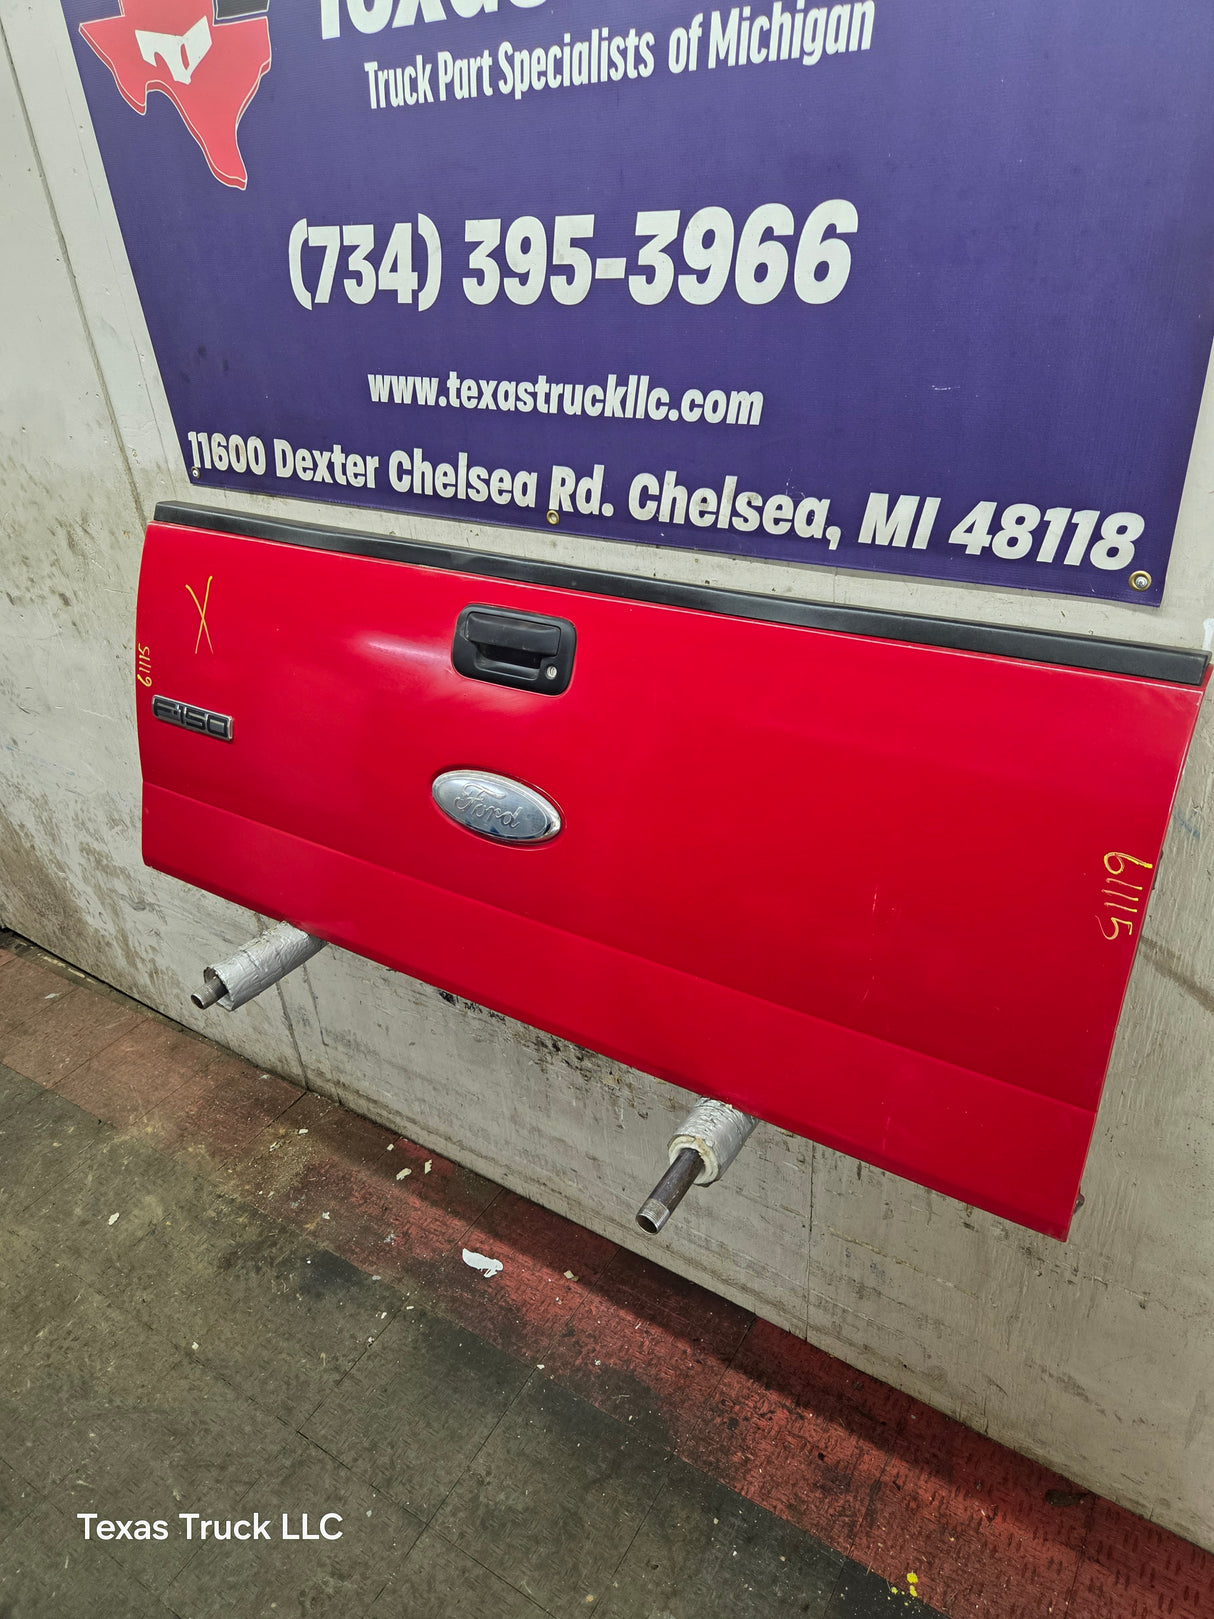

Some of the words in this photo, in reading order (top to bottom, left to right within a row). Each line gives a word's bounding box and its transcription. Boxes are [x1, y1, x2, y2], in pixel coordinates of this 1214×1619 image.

[364, 54, 435, 109] Truck
[437, 50, 494, 101] Part
[497, 27, 656, 101] Specialists
[668, 13, 704, 74] of
[708, 0, 876, 70] Michigan
[288, 212, 442, 312] (734)
[462, 198, 859, 306] 395-3966
[367, 371, 764, 427] www.texastruckllc.com
[187, 431, 266, 476] 11600
[273, 438, 379, 489] Dexter
[388, 447, 538, 508] Chelsea
[549, 463, 614, 517] Rd.
[628, 470, 842, 551] Chelsea,
[857, 492, 942, 550] MI
[948, 500, 1145, 571] 48118
[454, 782, 524, 829] Ford
[1094, 851, 1153, 940] 61115
